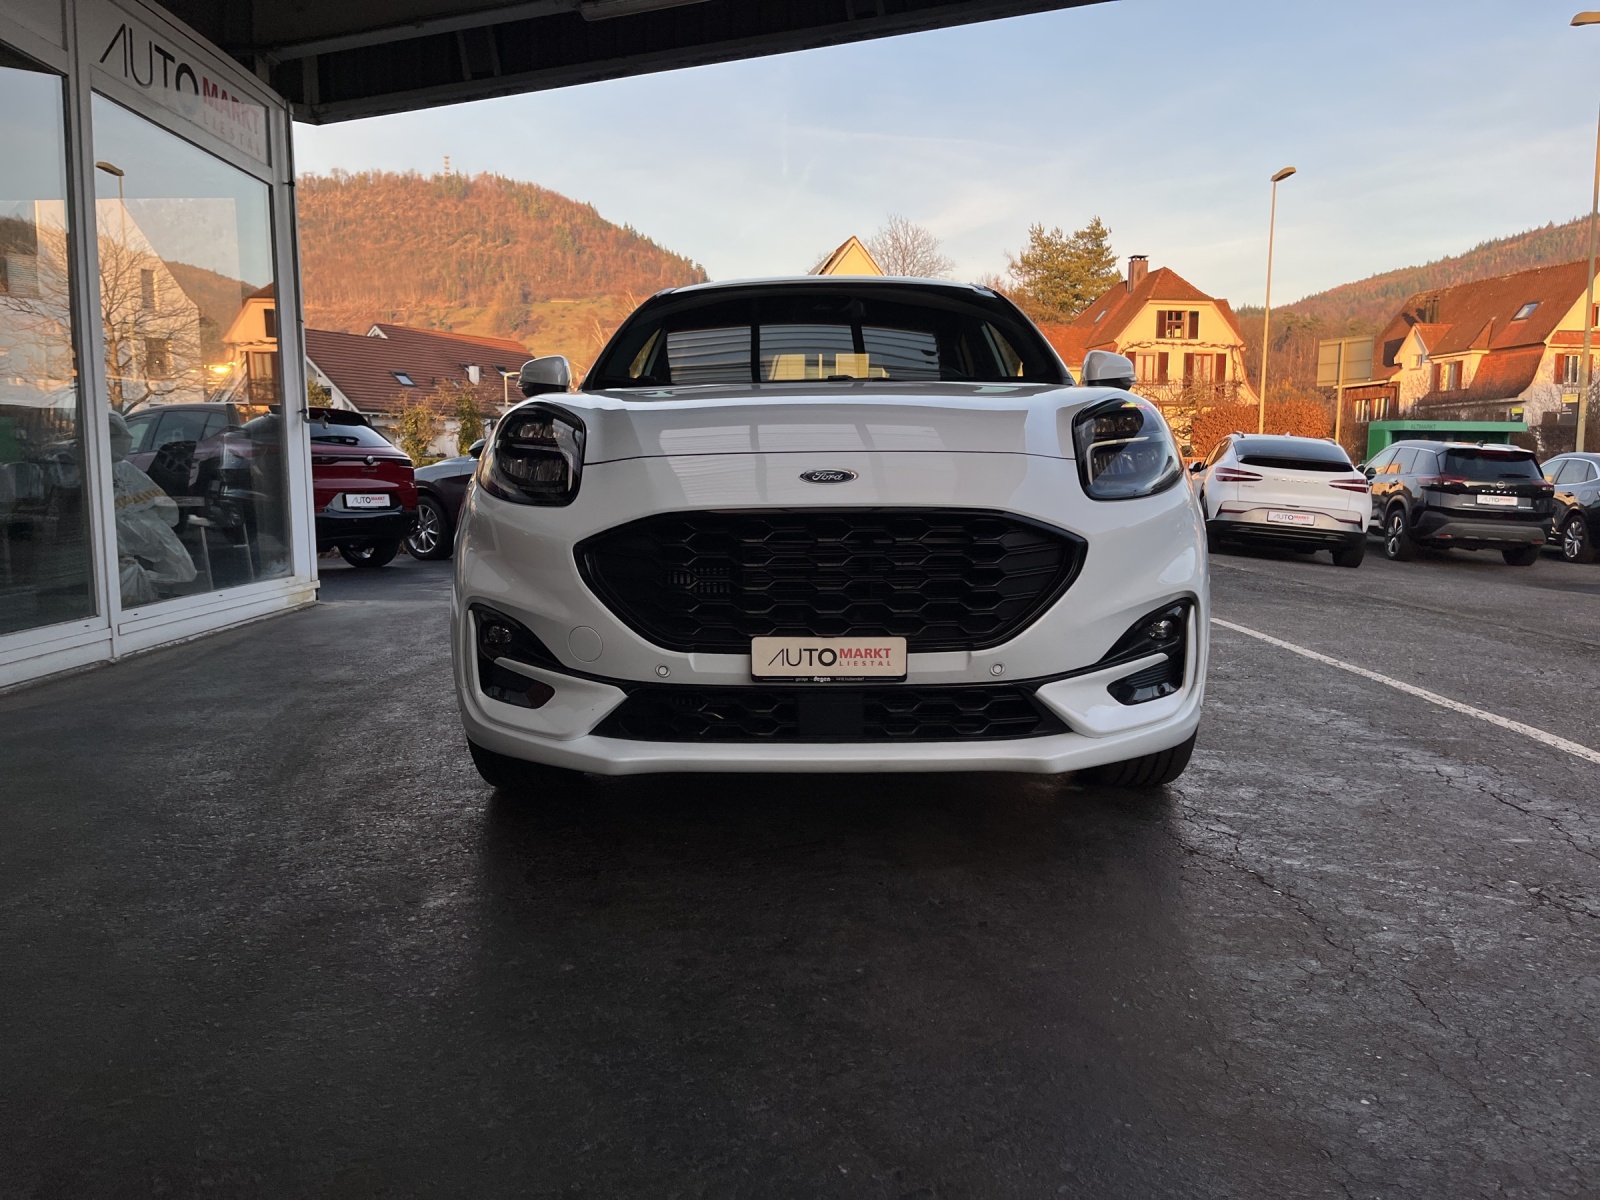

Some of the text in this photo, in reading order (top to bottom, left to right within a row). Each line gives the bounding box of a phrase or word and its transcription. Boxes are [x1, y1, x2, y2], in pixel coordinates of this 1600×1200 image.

[99, 23, 260, 135] AUTO MARKT
[811, 471, 844, 481] Ford
[352, 496, 372, 504] AUTO
[1273, 513, 1294, 521] AUTO
[767, 647, 892, 667] AUTO MARKT
